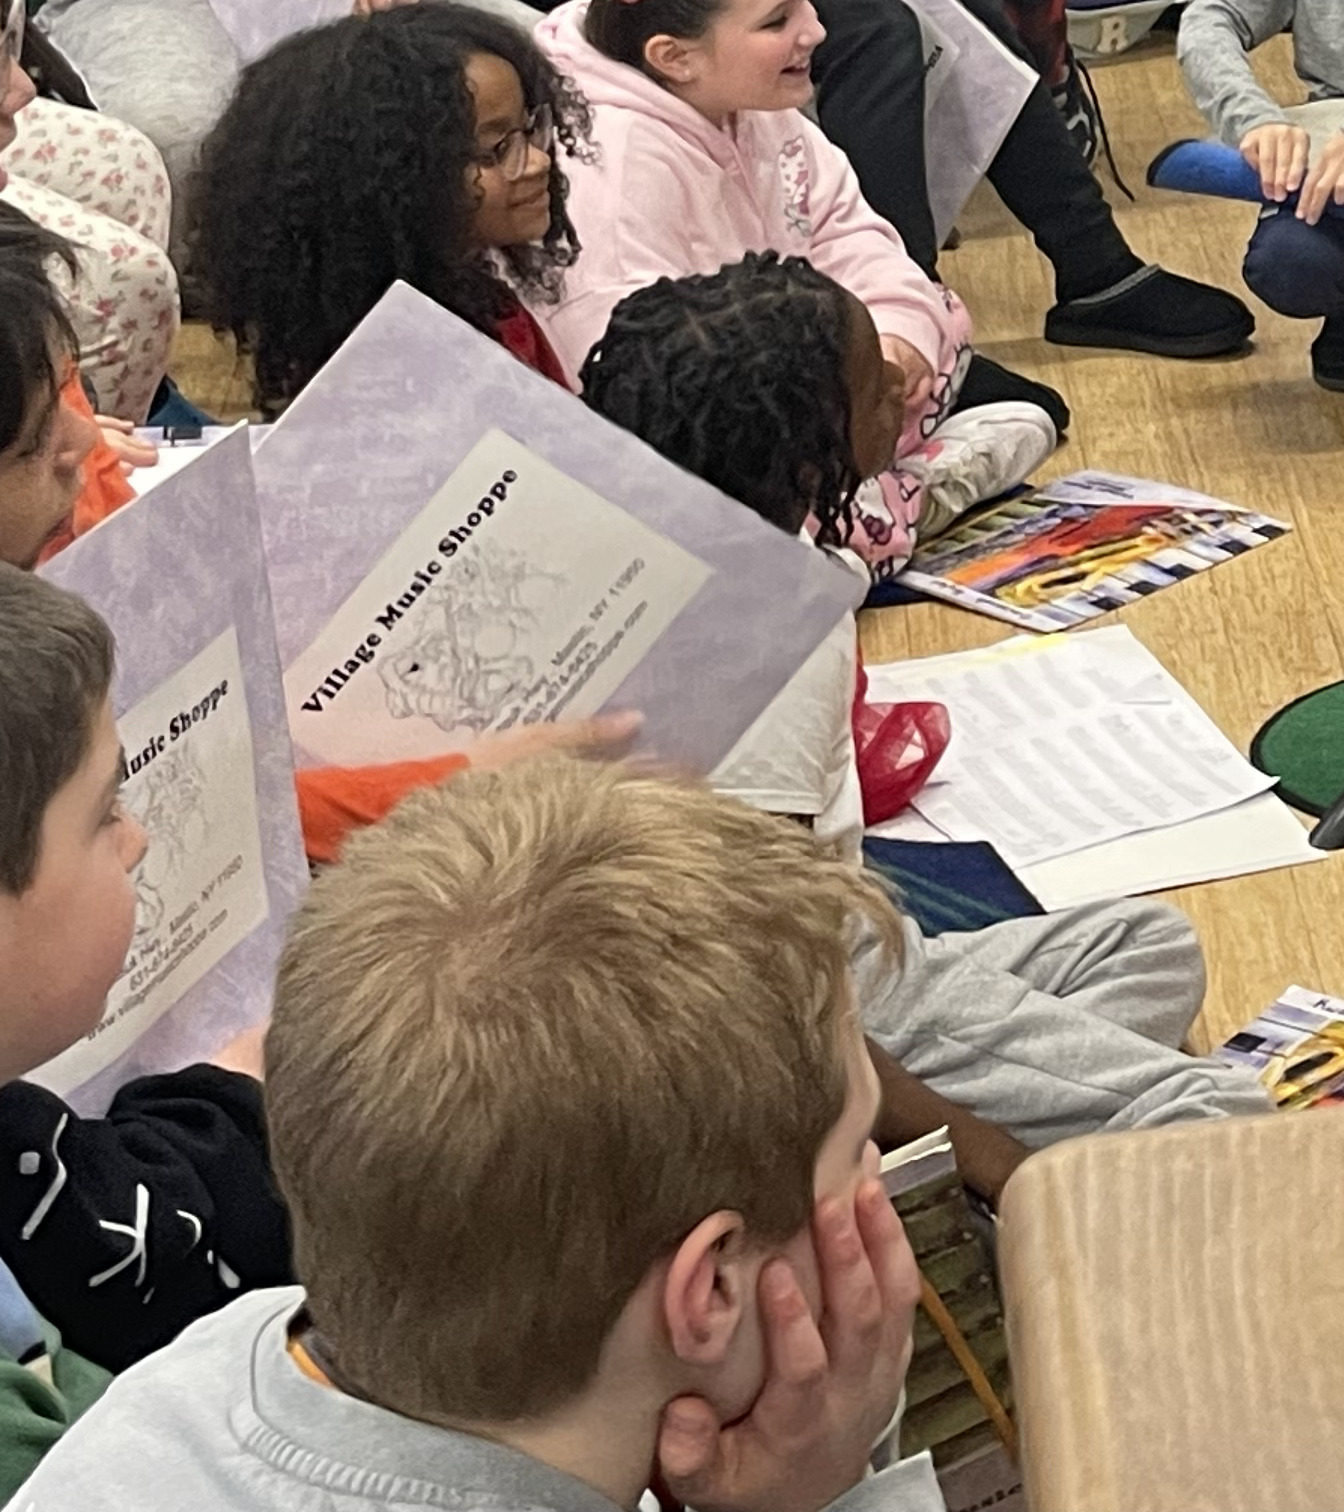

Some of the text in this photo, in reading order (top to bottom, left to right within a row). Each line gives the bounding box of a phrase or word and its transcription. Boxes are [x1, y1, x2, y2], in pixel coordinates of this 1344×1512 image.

[301, 470, 518, 713] Village Music Shoppe
[168, 680, 228, 743] Shoppe
